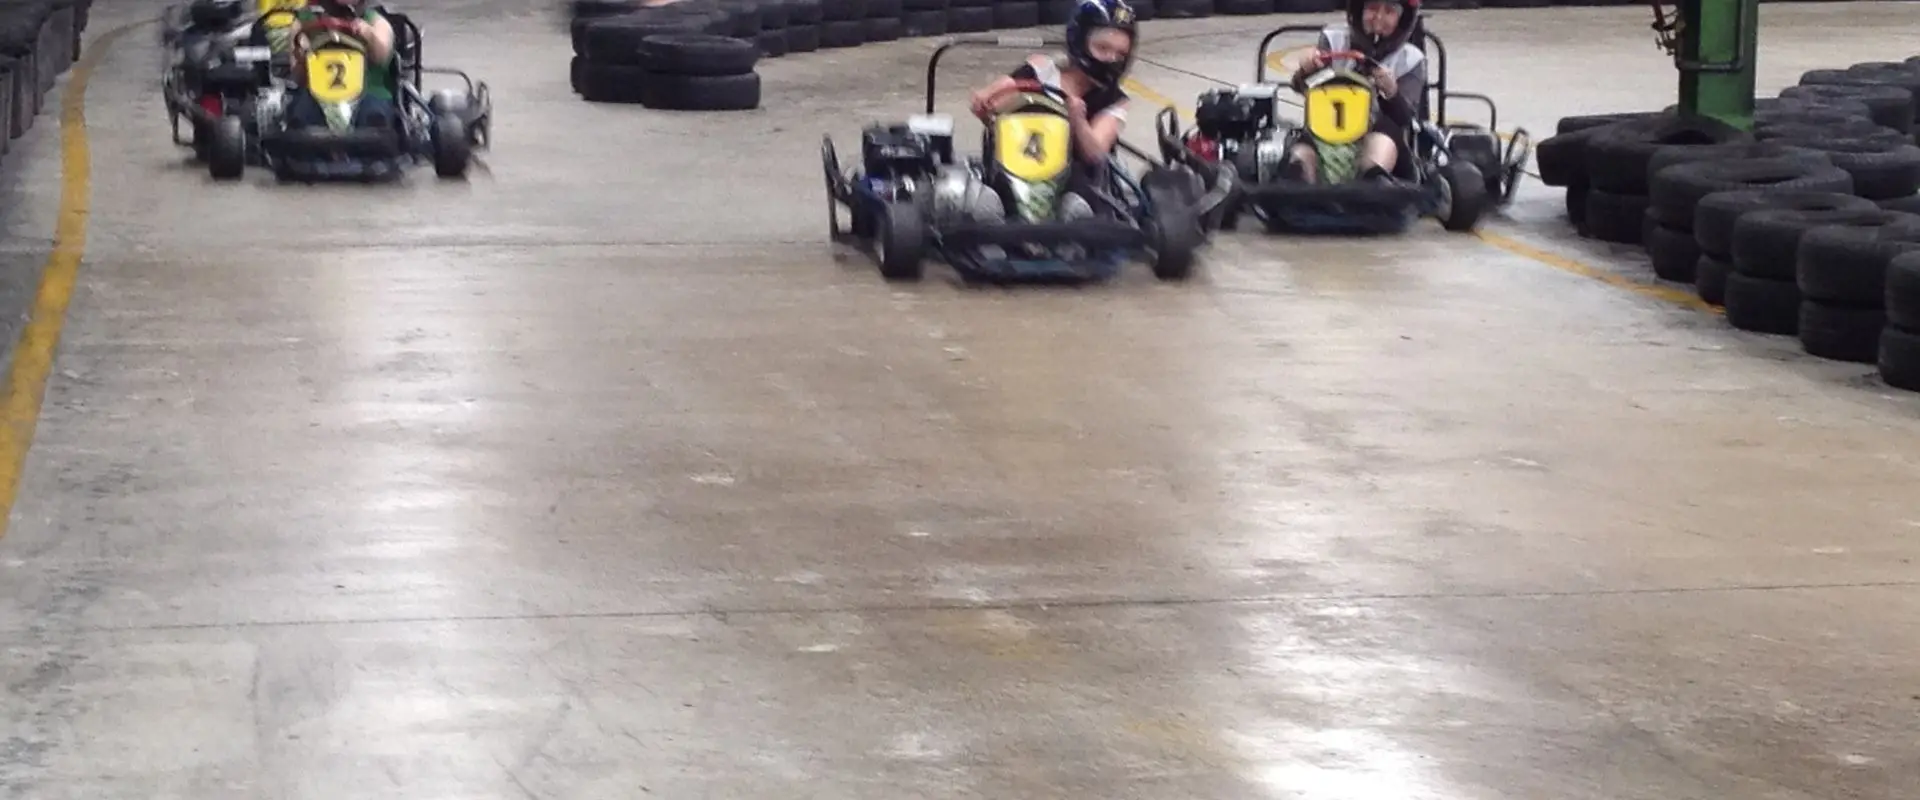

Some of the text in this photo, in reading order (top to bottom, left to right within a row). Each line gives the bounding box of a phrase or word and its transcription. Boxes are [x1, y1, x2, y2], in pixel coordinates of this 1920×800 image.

[326, 64, 346, 90] 2
[1331, 101, 1345, 131] 1
[1022, 132, 1047, 163] 4
